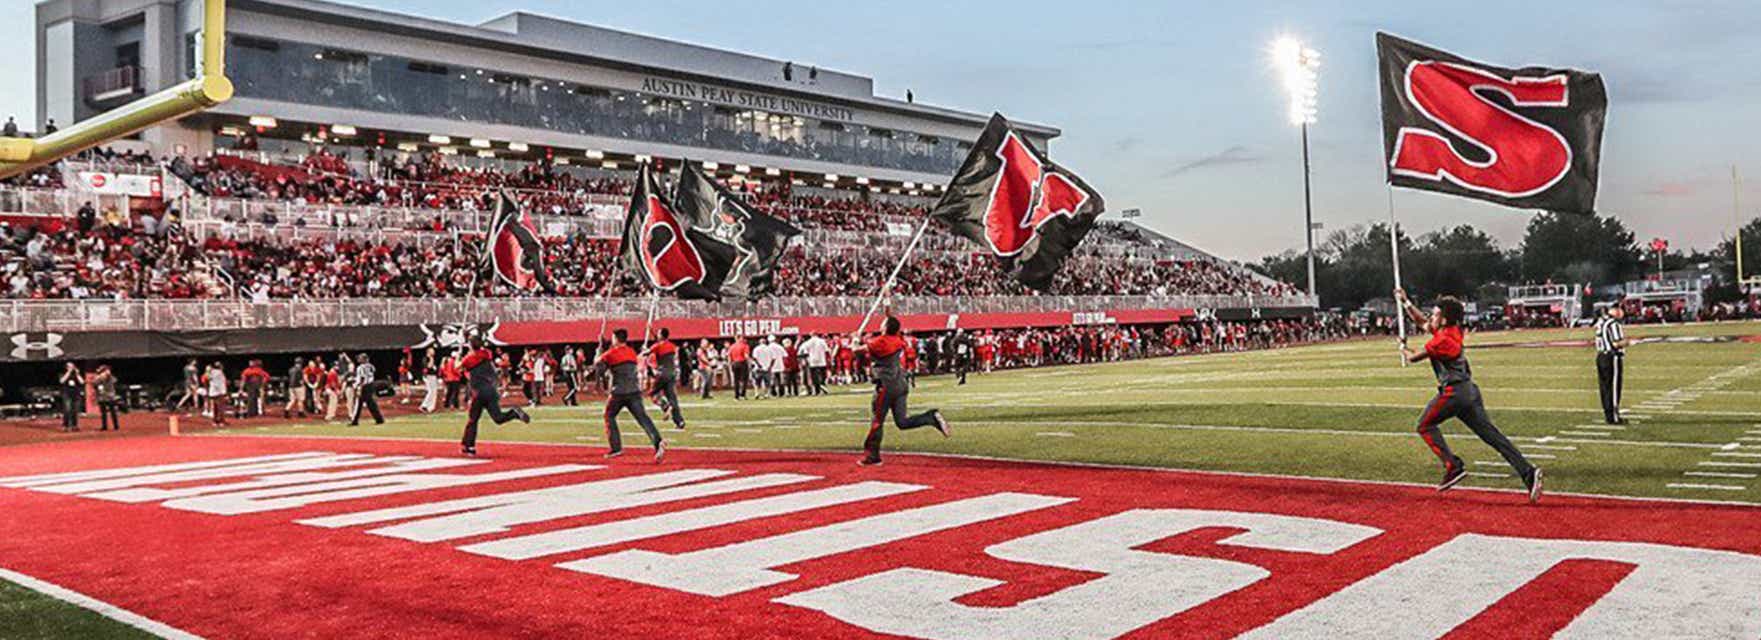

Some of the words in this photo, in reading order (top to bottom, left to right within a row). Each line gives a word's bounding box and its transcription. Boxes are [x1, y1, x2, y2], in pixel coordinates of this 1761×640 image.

[642, 78, 696, 97] AUSTIN
[701, 85, 735, 103] PEAY
[739, 92, 778, 110] STATE
[781, 98, 855, 120] UNIVERSITY
[1390, 59, 1573, 198] S
[744, 319, 758, 336] GO
